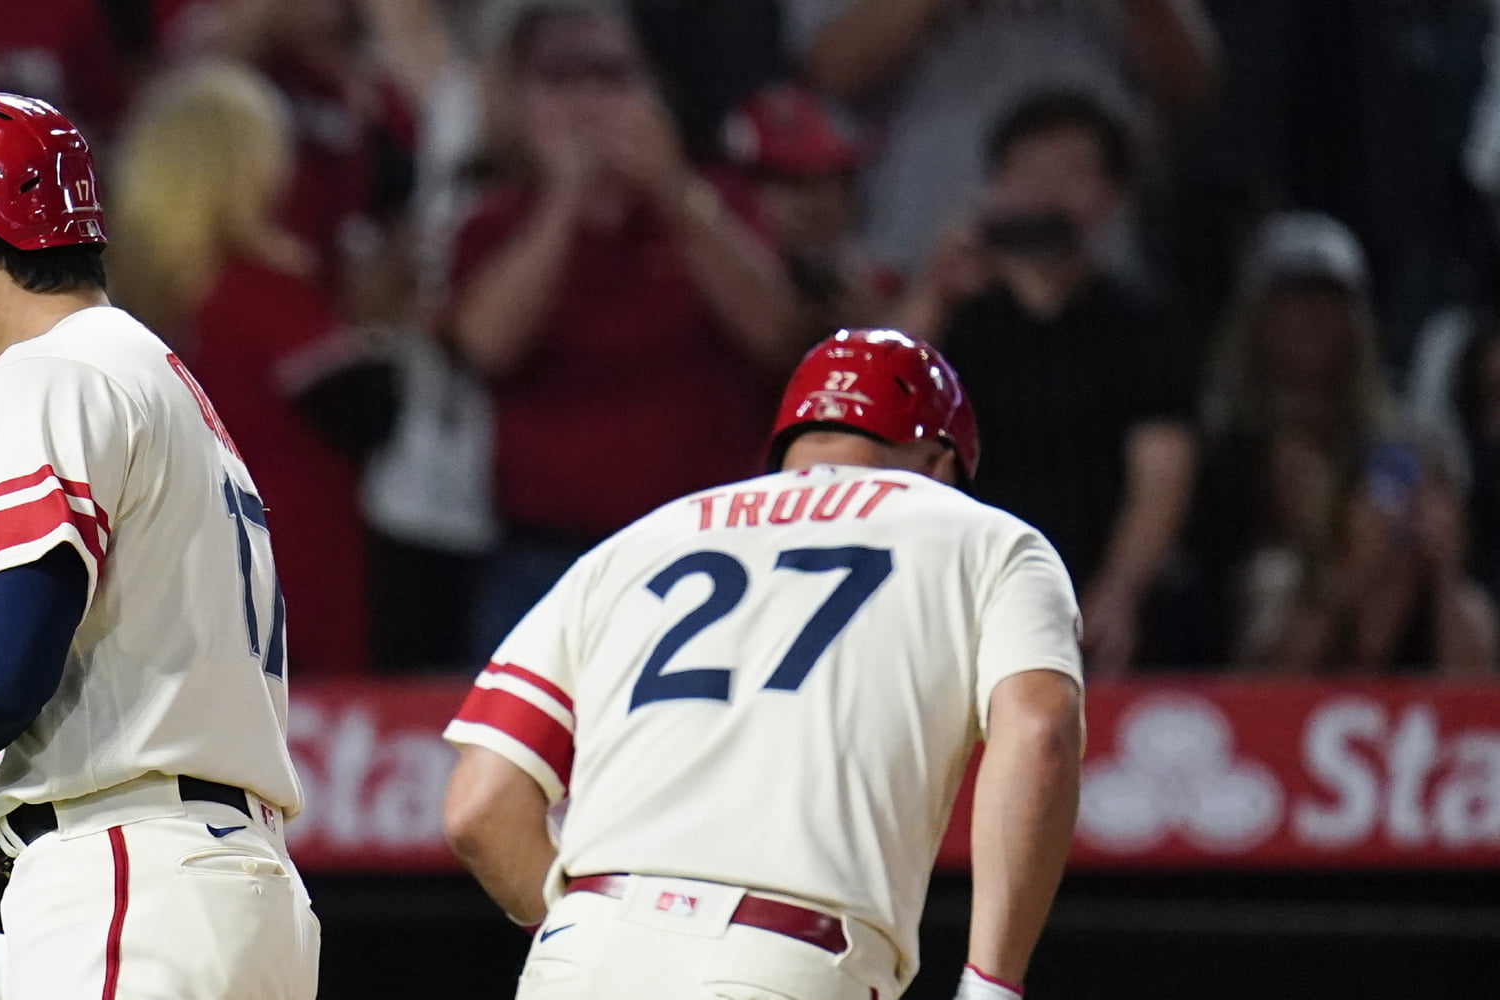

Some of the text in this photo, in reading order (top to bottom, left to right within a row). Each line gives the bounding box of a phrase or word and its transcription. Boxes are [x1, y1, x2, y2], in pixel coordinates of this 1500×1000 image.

[75, 179, 89, 201] 17
[824, 370, 858, 391] 27
[689, 479, 909, 531] TROUT
[626, 545, 895, 717] 27
